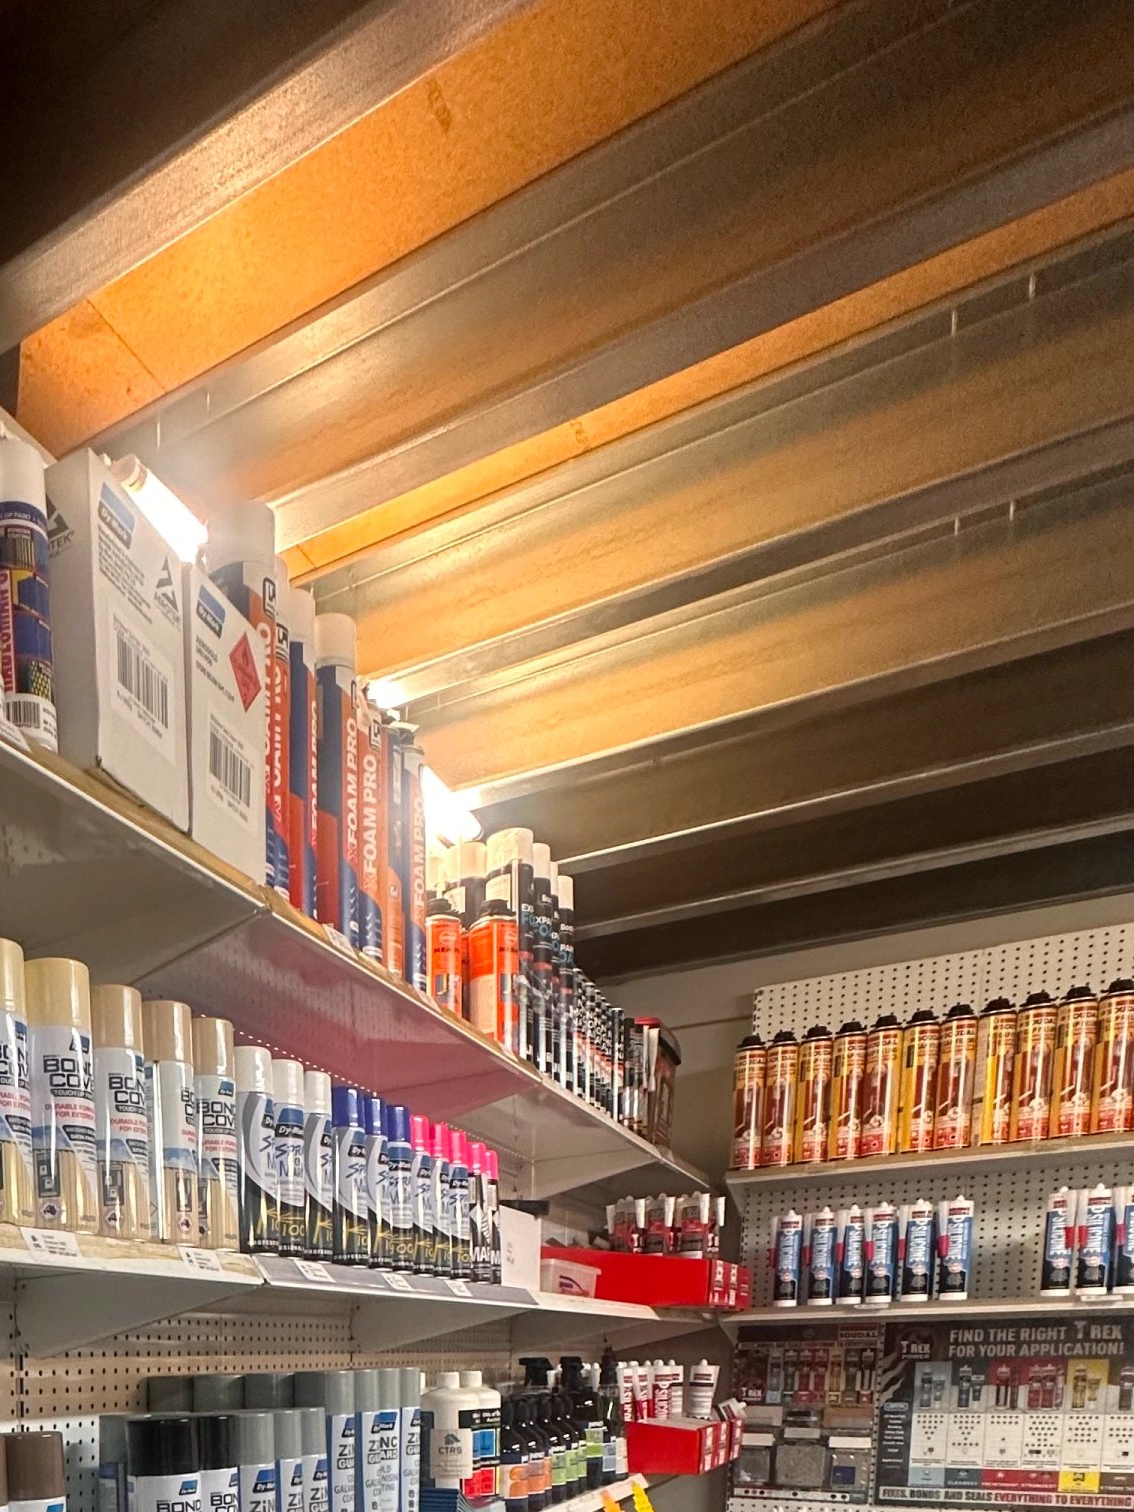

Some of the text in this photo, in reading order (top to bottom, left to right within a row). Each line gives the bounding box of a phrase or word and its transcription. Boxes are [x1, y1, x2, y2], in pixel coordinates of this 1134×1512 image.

[363, 754, 377, 801] PRO
[950, 1329, 985, 1343] FIND
[989, 1328, 1015, 1341] THE
[1019, 1326, 1067, 1340] RIGHT
[1090, 1324, 1122, 1339] REX
[911, 1344, 930, 1354] REX
[948, 1342, 1124, 1357] FOR YOUR APPLICATION!
[909, 1490, 941, 1499] BONDS
[944, 1490, 963, 1500] AND
[965, 1491, 992, 1501] SEALS
[994, 1493, 1052, 1504] EVERYTHING
[1055, 1495, 1067, 1505] TO
[1070, 1496, 1132, 1508] EVERYTHING
